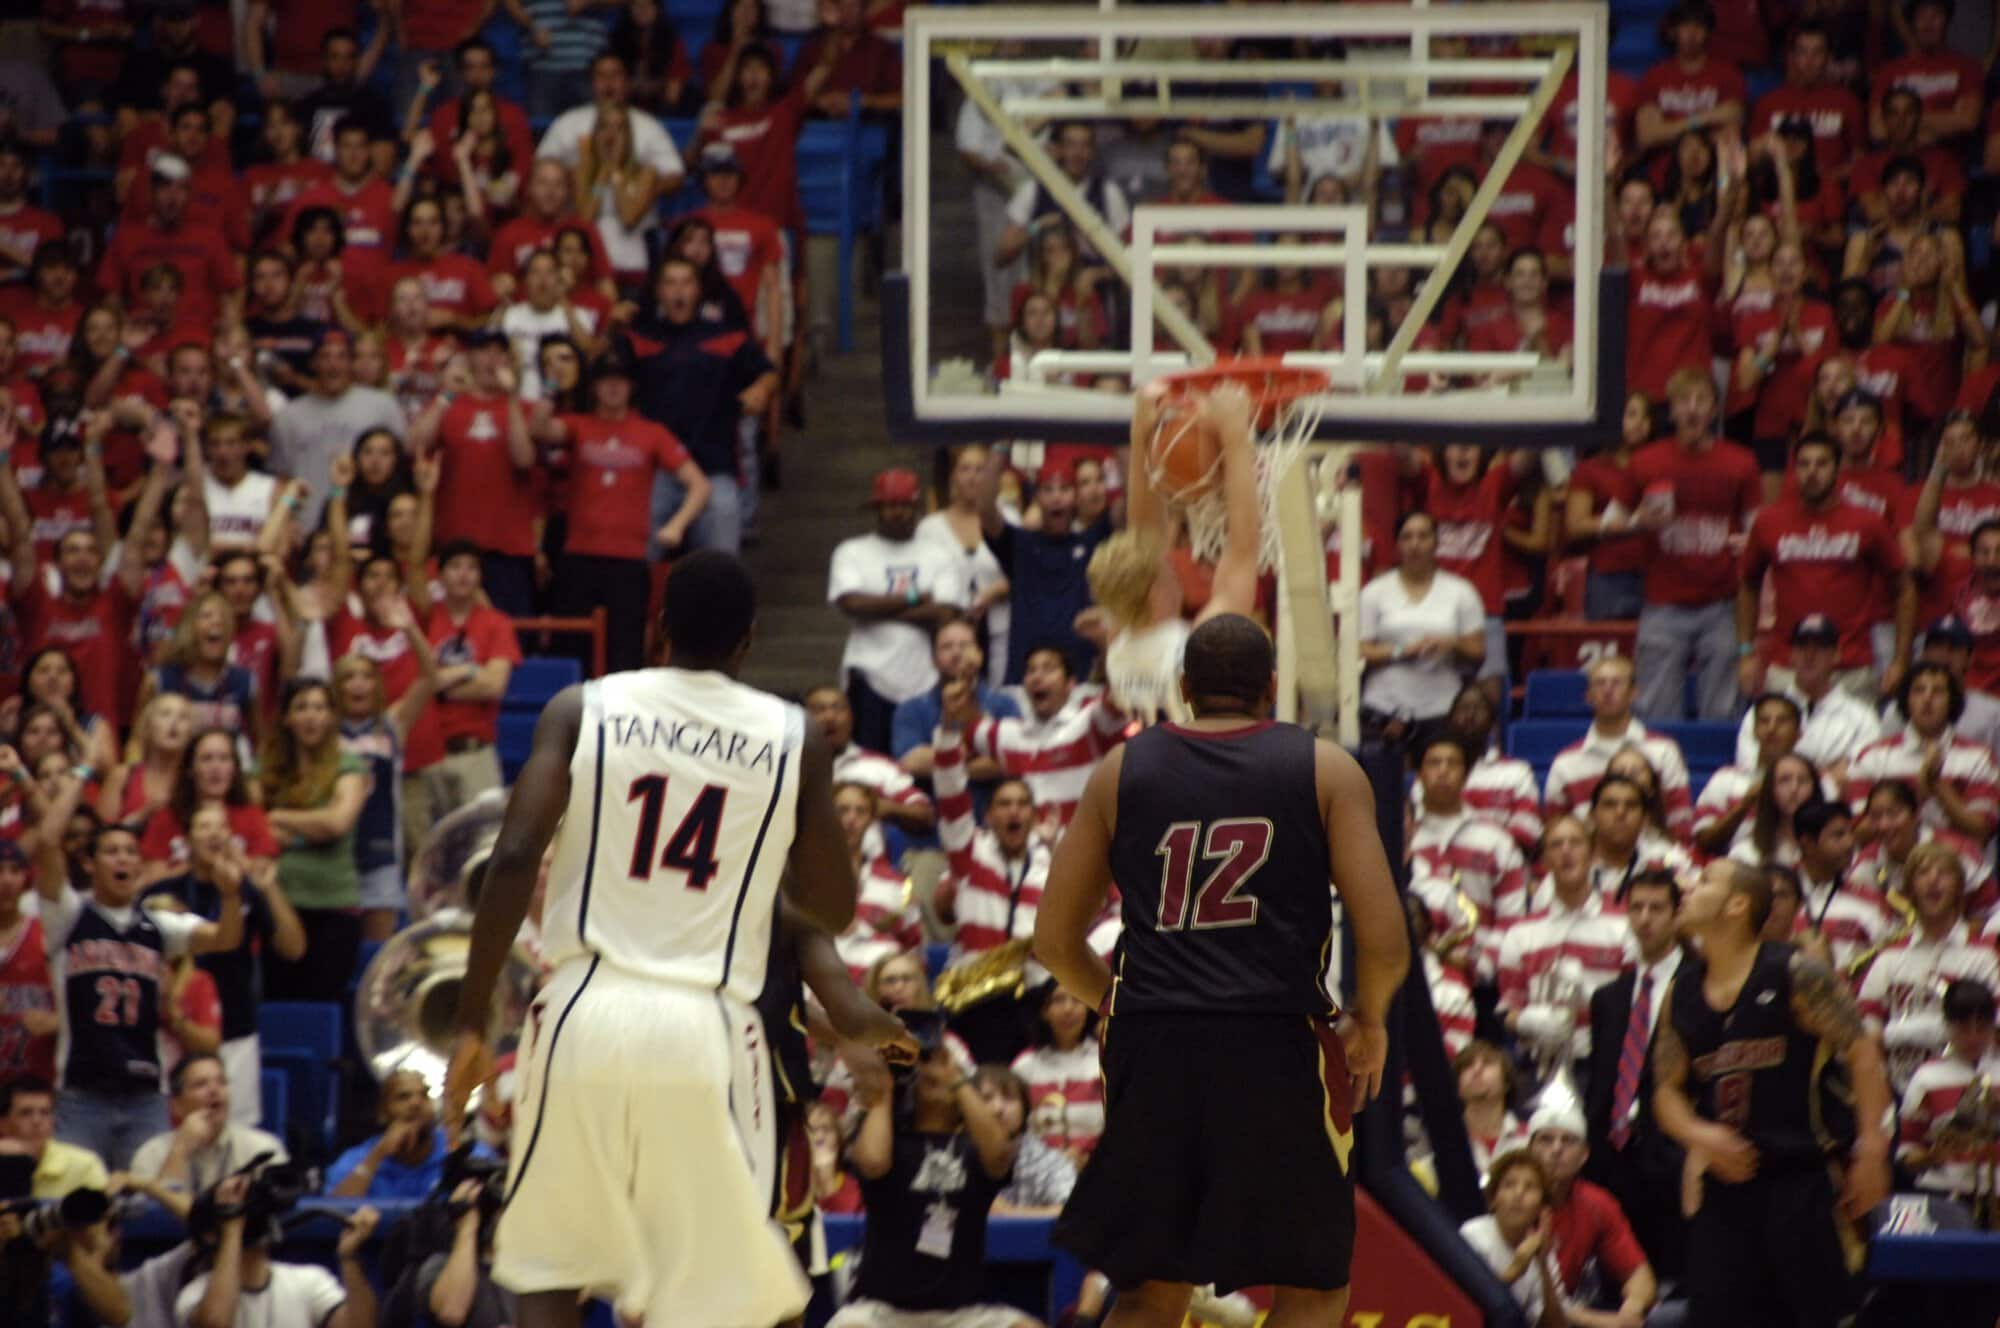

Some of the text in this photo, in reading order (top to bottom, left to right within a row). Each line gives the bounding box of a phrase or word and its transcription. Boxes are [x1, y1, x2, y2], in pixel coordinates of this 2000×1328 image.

[608, 713, 774, 773] TANGARA
[628, 773, 729, 891] 14
[1155, 817, 1274, 931] 12
[95, 975, 140, 1025] 21
